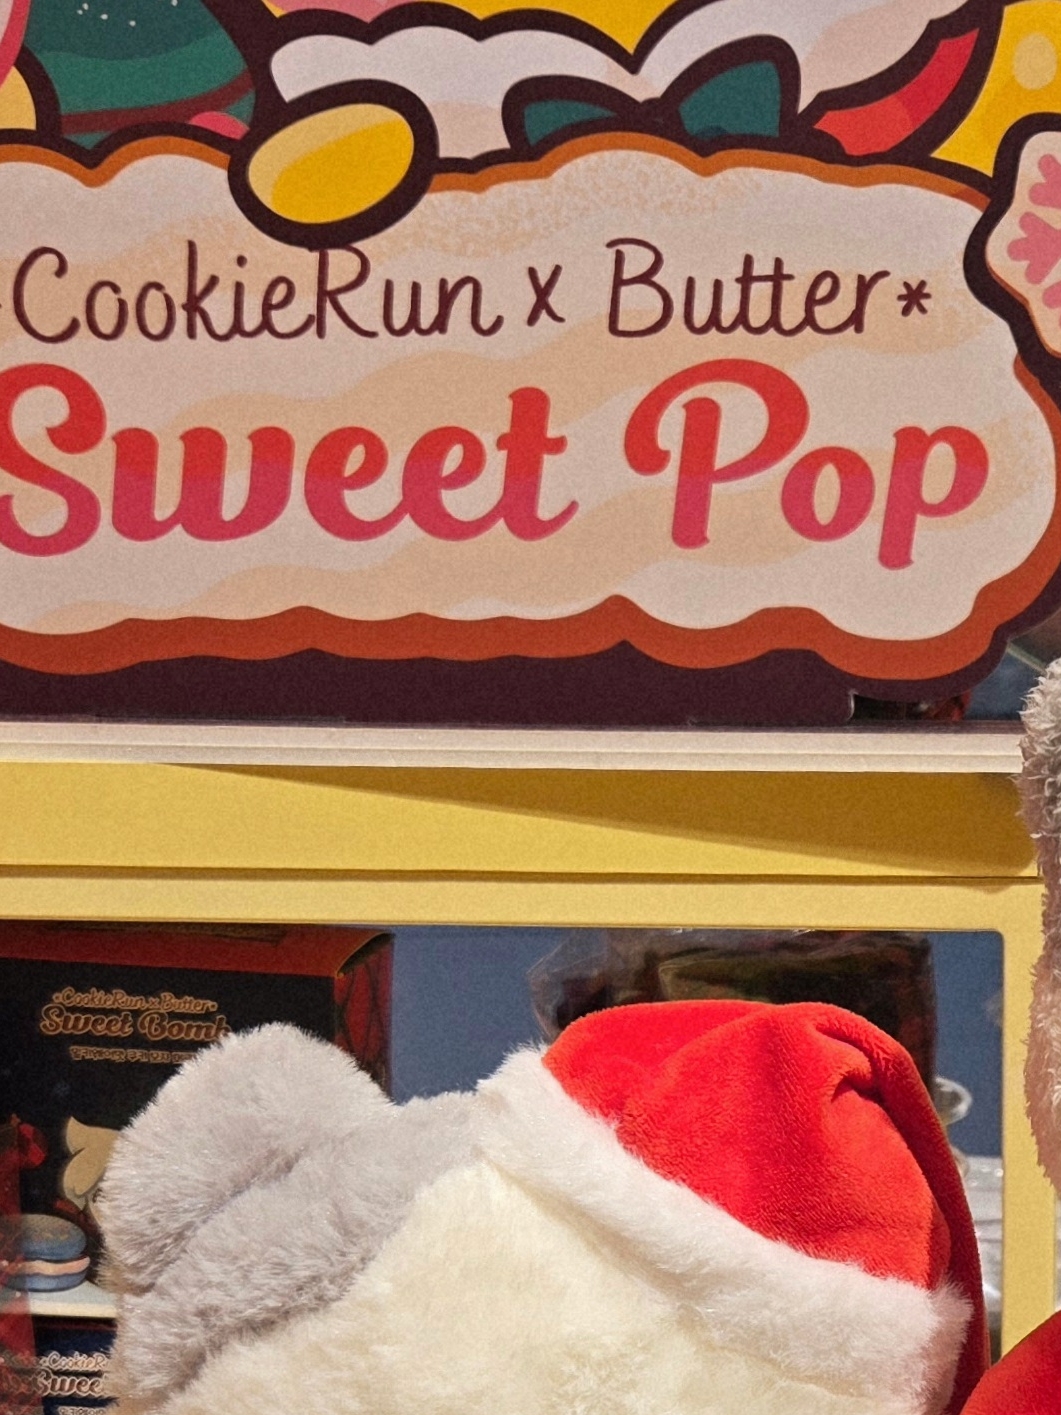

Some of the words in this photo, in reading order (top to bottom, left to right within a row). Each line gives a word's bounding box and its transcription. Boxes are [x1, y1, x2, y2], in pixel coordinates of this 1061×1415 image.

[12, 239, 504, 344] CookieRun
[0, 362, 580, 558] Sweet
[623, 358, 991, 571] Pop
[40, 1003, 133, 1037] Sweet
[32, 1366, 108, 1397] Swee
